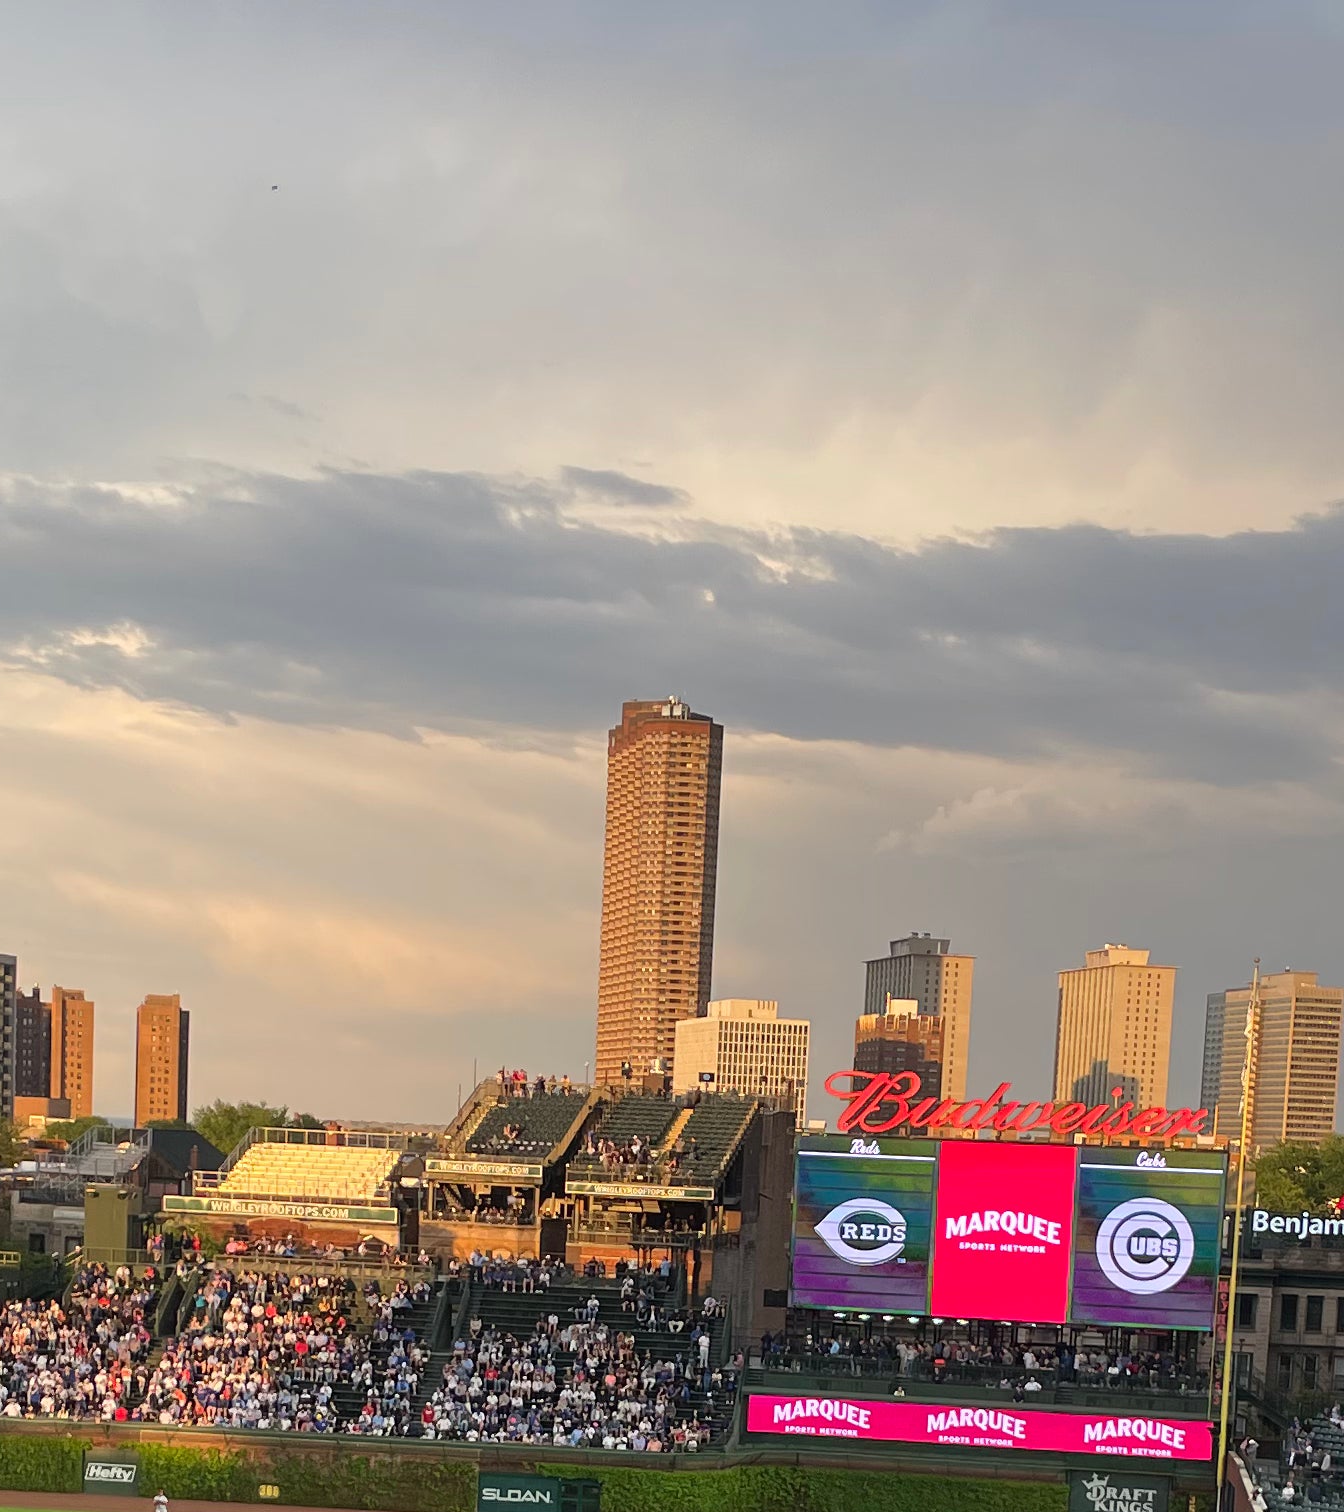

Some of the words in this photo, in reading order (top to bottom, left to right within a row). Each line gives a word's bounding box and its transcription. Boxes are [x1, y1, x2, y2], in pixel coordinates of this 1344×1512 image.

[824, 1070, 1208, 1139] Budweiser
[850, 1138, 880, 1155] Reds
[1136, 1151, 1166, 1168] Cubs
[210, 1200, 349, 1219] WRIGLEYROOFTOPS.COM
[841, 1222, 906, 1243] REDS
[946, 1210, 1061, 1246] MARQUEE
[959, 1241, 996, 1251] SPORTS
[1000, 1244, 1046, 1254] NETWORK
[773, 1398, 871, 1430] MARQUEE
[927, 1407, 1026, 1440] MARQUEE
[1083, 1417, 1186, 1450] MARQUEE
[89, 1464, 133, 1482] Hefty
[481, 1487, 551, 1503] SLOAN
[1086, 1484, 1157, 1502] DRAFT
